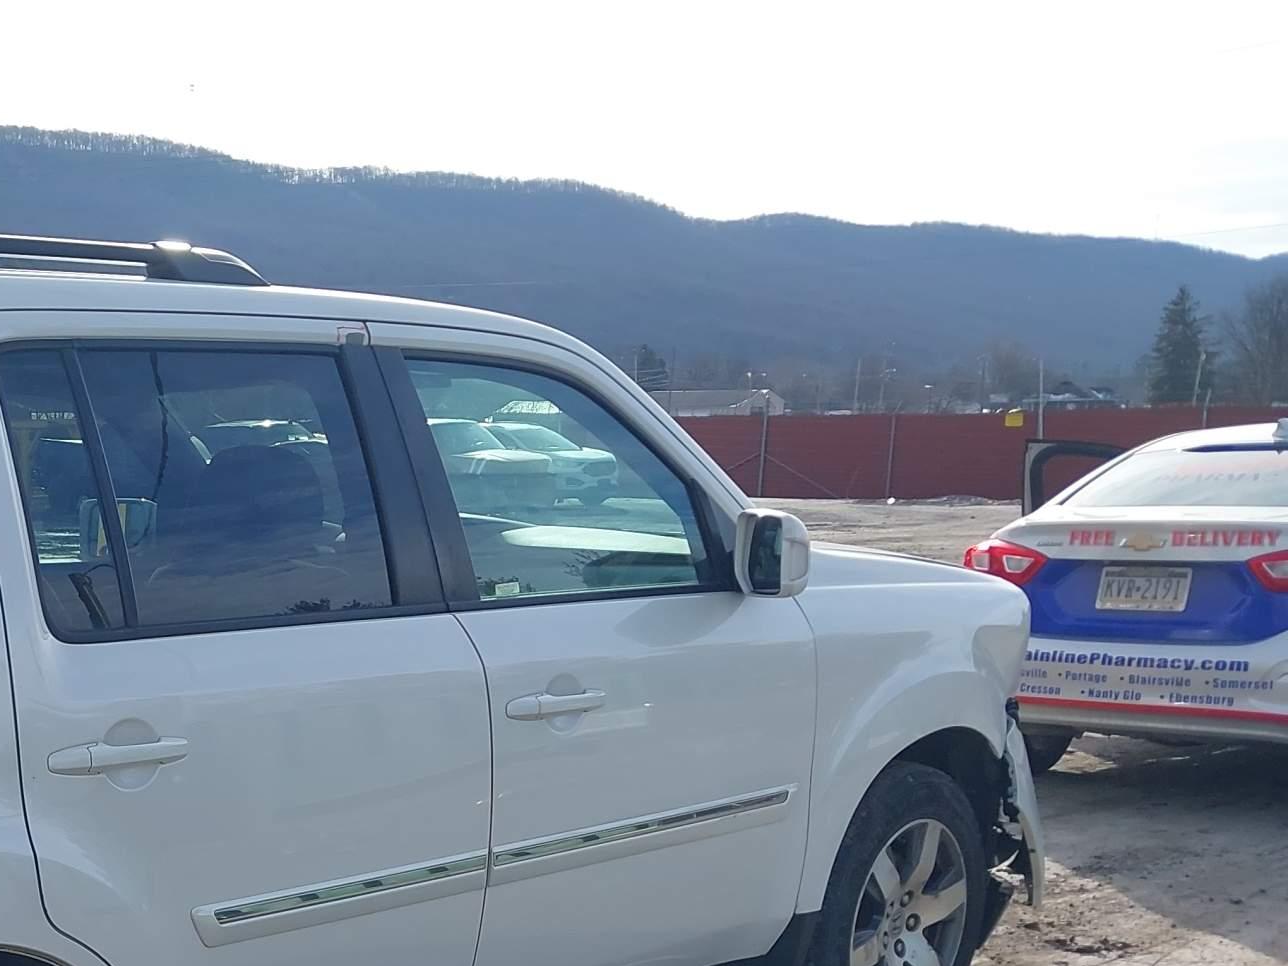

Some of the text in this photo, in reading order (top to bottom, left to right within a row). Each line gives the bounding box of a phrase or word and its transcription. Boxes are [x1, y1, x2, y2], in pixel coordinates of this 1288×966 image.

[1068, 529, 1280, 547] FREE DELIVERY
[1025, 649, 1249, 672] ainlinePharmacy.com
[1065, 671, 1107, 683] Portage
[1128, 674, 1191, 687] Blairsville
[1213, 678, 1273, 689] Somerset
[1020, 682, 1061, 695] Cresson
[1169, 692, 1234, 706] Ebensburg
